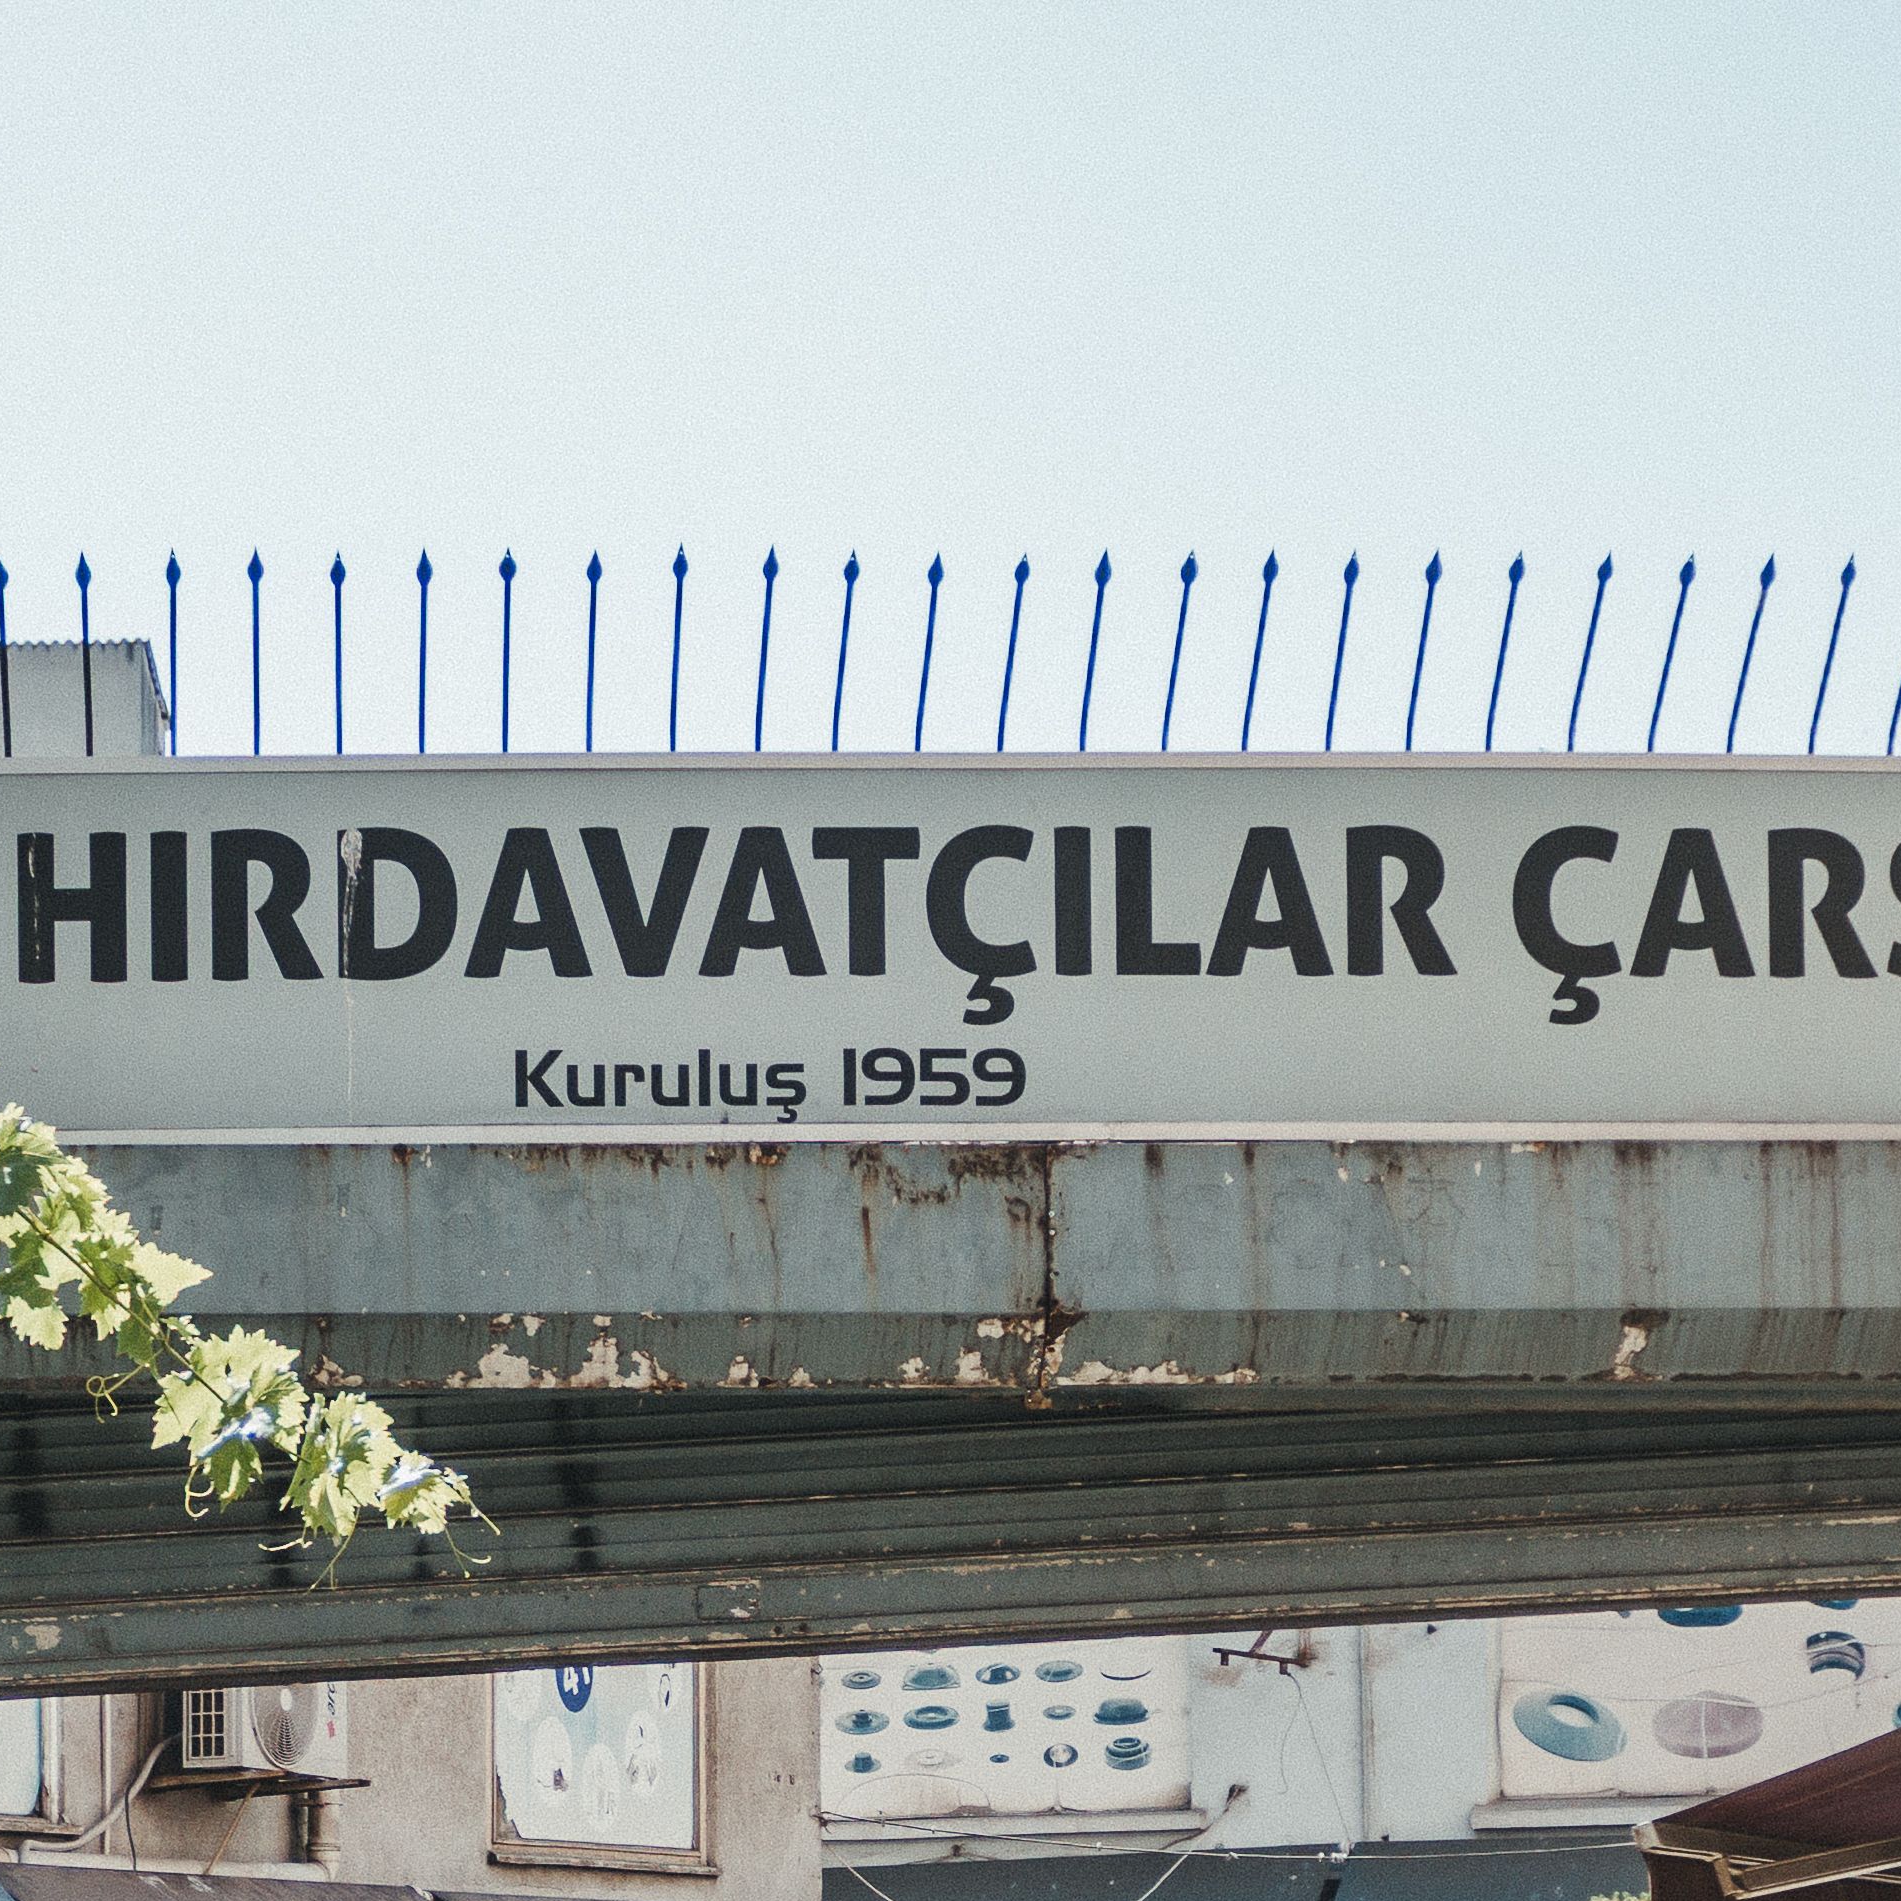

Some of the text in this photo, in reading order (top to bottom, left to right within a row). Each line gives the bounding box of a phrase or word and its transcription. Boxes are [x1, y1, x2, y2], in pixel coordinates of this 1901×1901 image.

[16, 824, 1458, 1025] HIRDAVATÇILAR
[514, 1047, 1027, 1124] Kuruluş 1959
